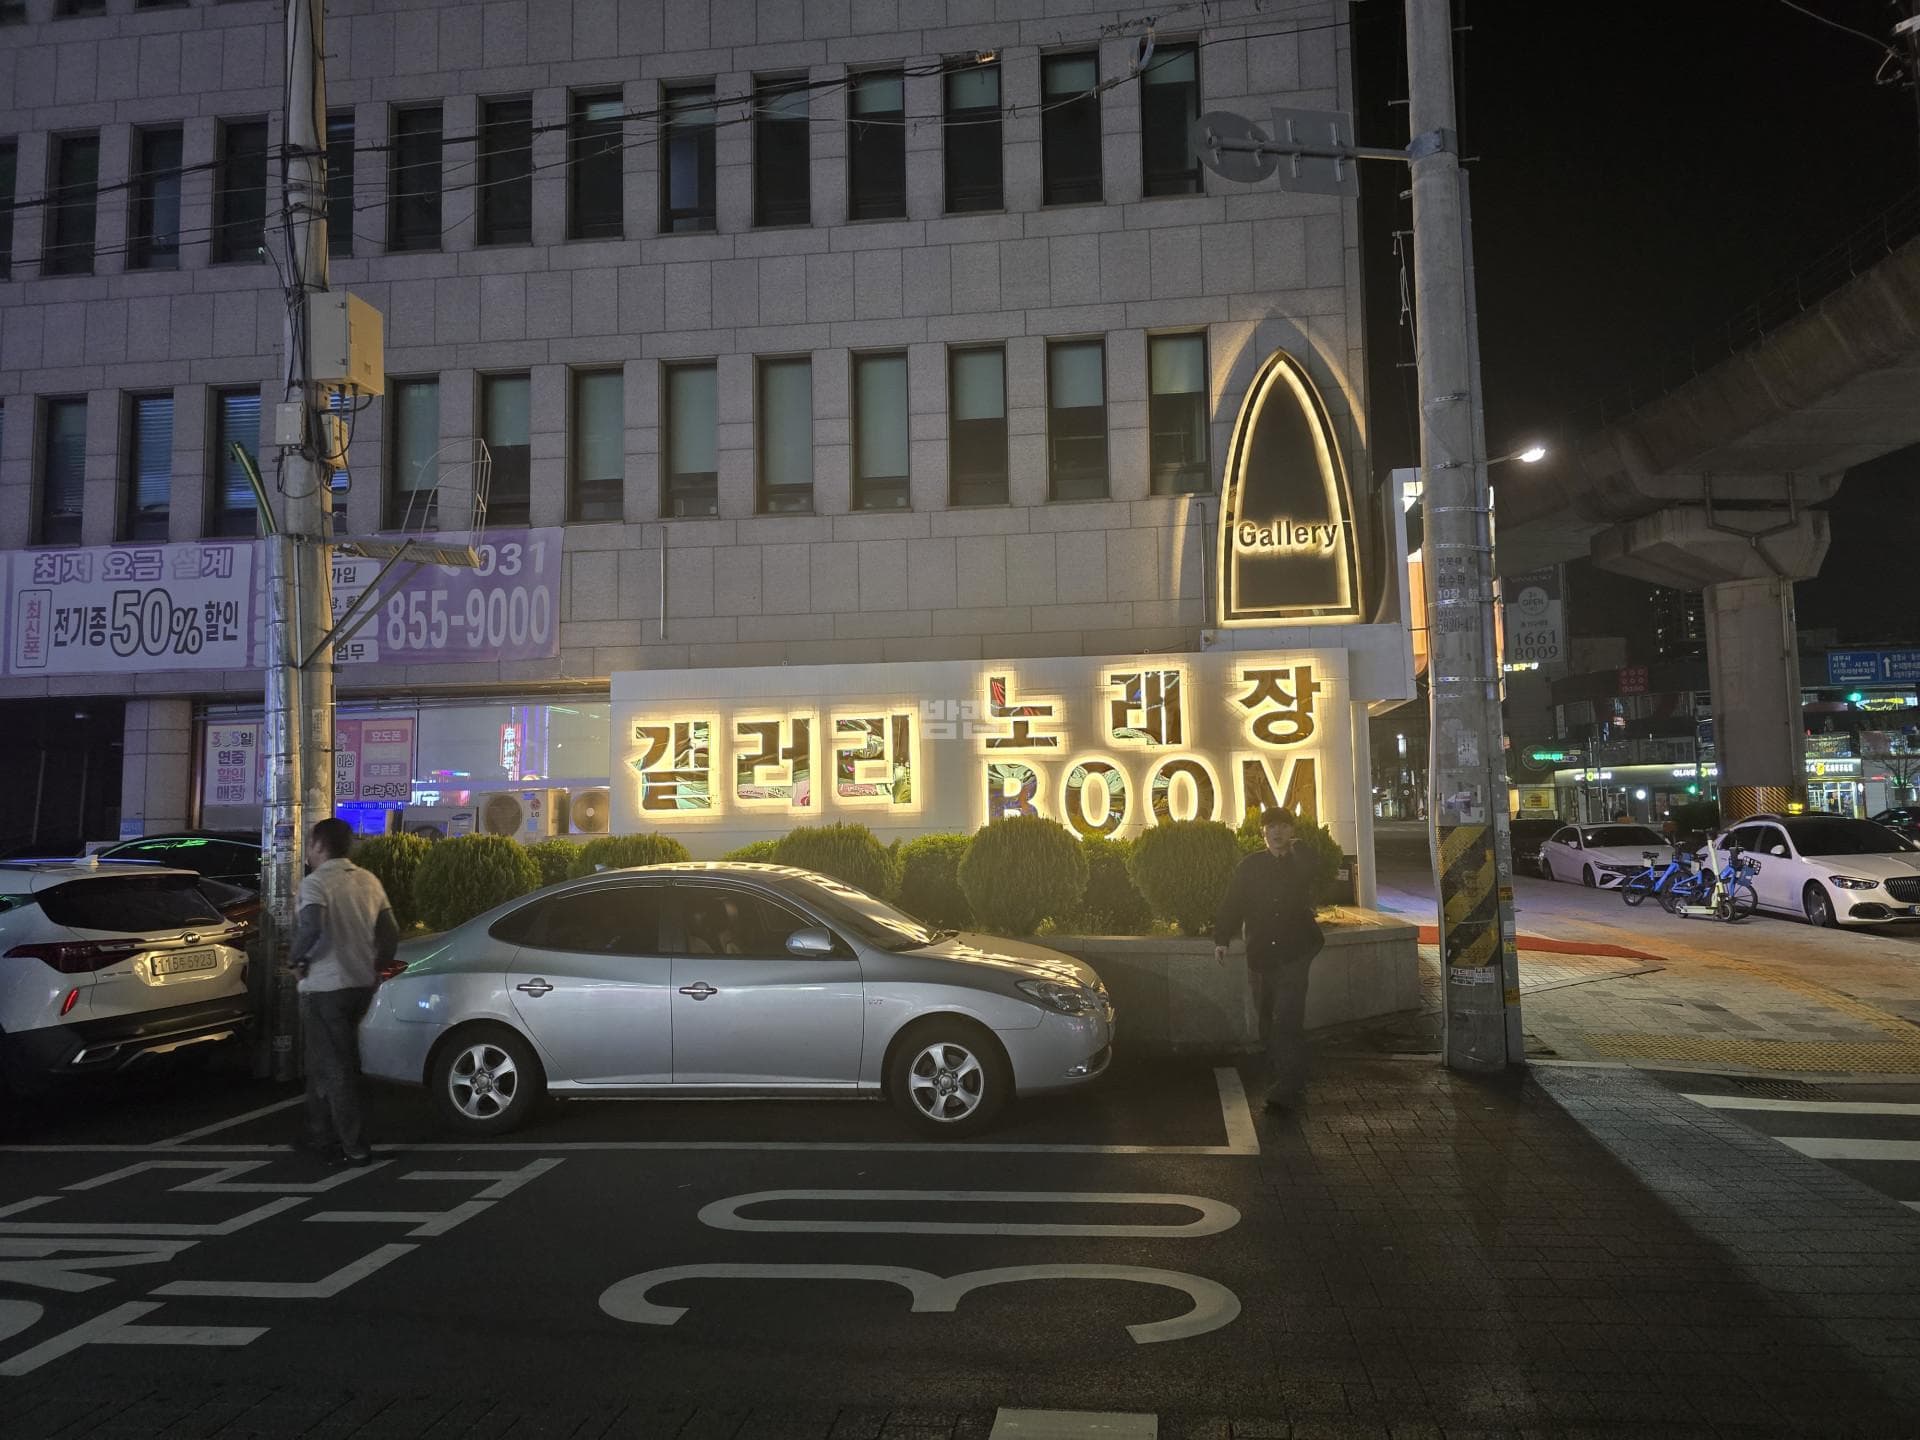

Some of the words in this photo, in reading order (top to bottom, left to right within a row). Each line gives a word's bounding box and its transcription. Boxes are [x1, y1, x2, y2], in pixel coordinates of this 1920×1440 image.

[473, 541, 547, 577] 031
[1238, 520, 1338, 547] Gallery
[33, 553, 93, 585] 최저
[102, 550, 163, 582] 요금
[23, 600, 42, 660] 최신폰
[54, 606, 107, 647] 전기종
[110, 588, 203, 657] 50%
[204, 600, 239, 641] 할인
[386, 585, 551, 650] 855-9000
[1514, 630, 1556, 646] 1661
[1514, 645, 1558, 661] 8009
[986, 665, 1321, 748] 노래장
[630, 713, 912, 811] 갤러리
[987, 757, 1318, 835] ROOM
[599, 1189, 1241, 1344] 30
